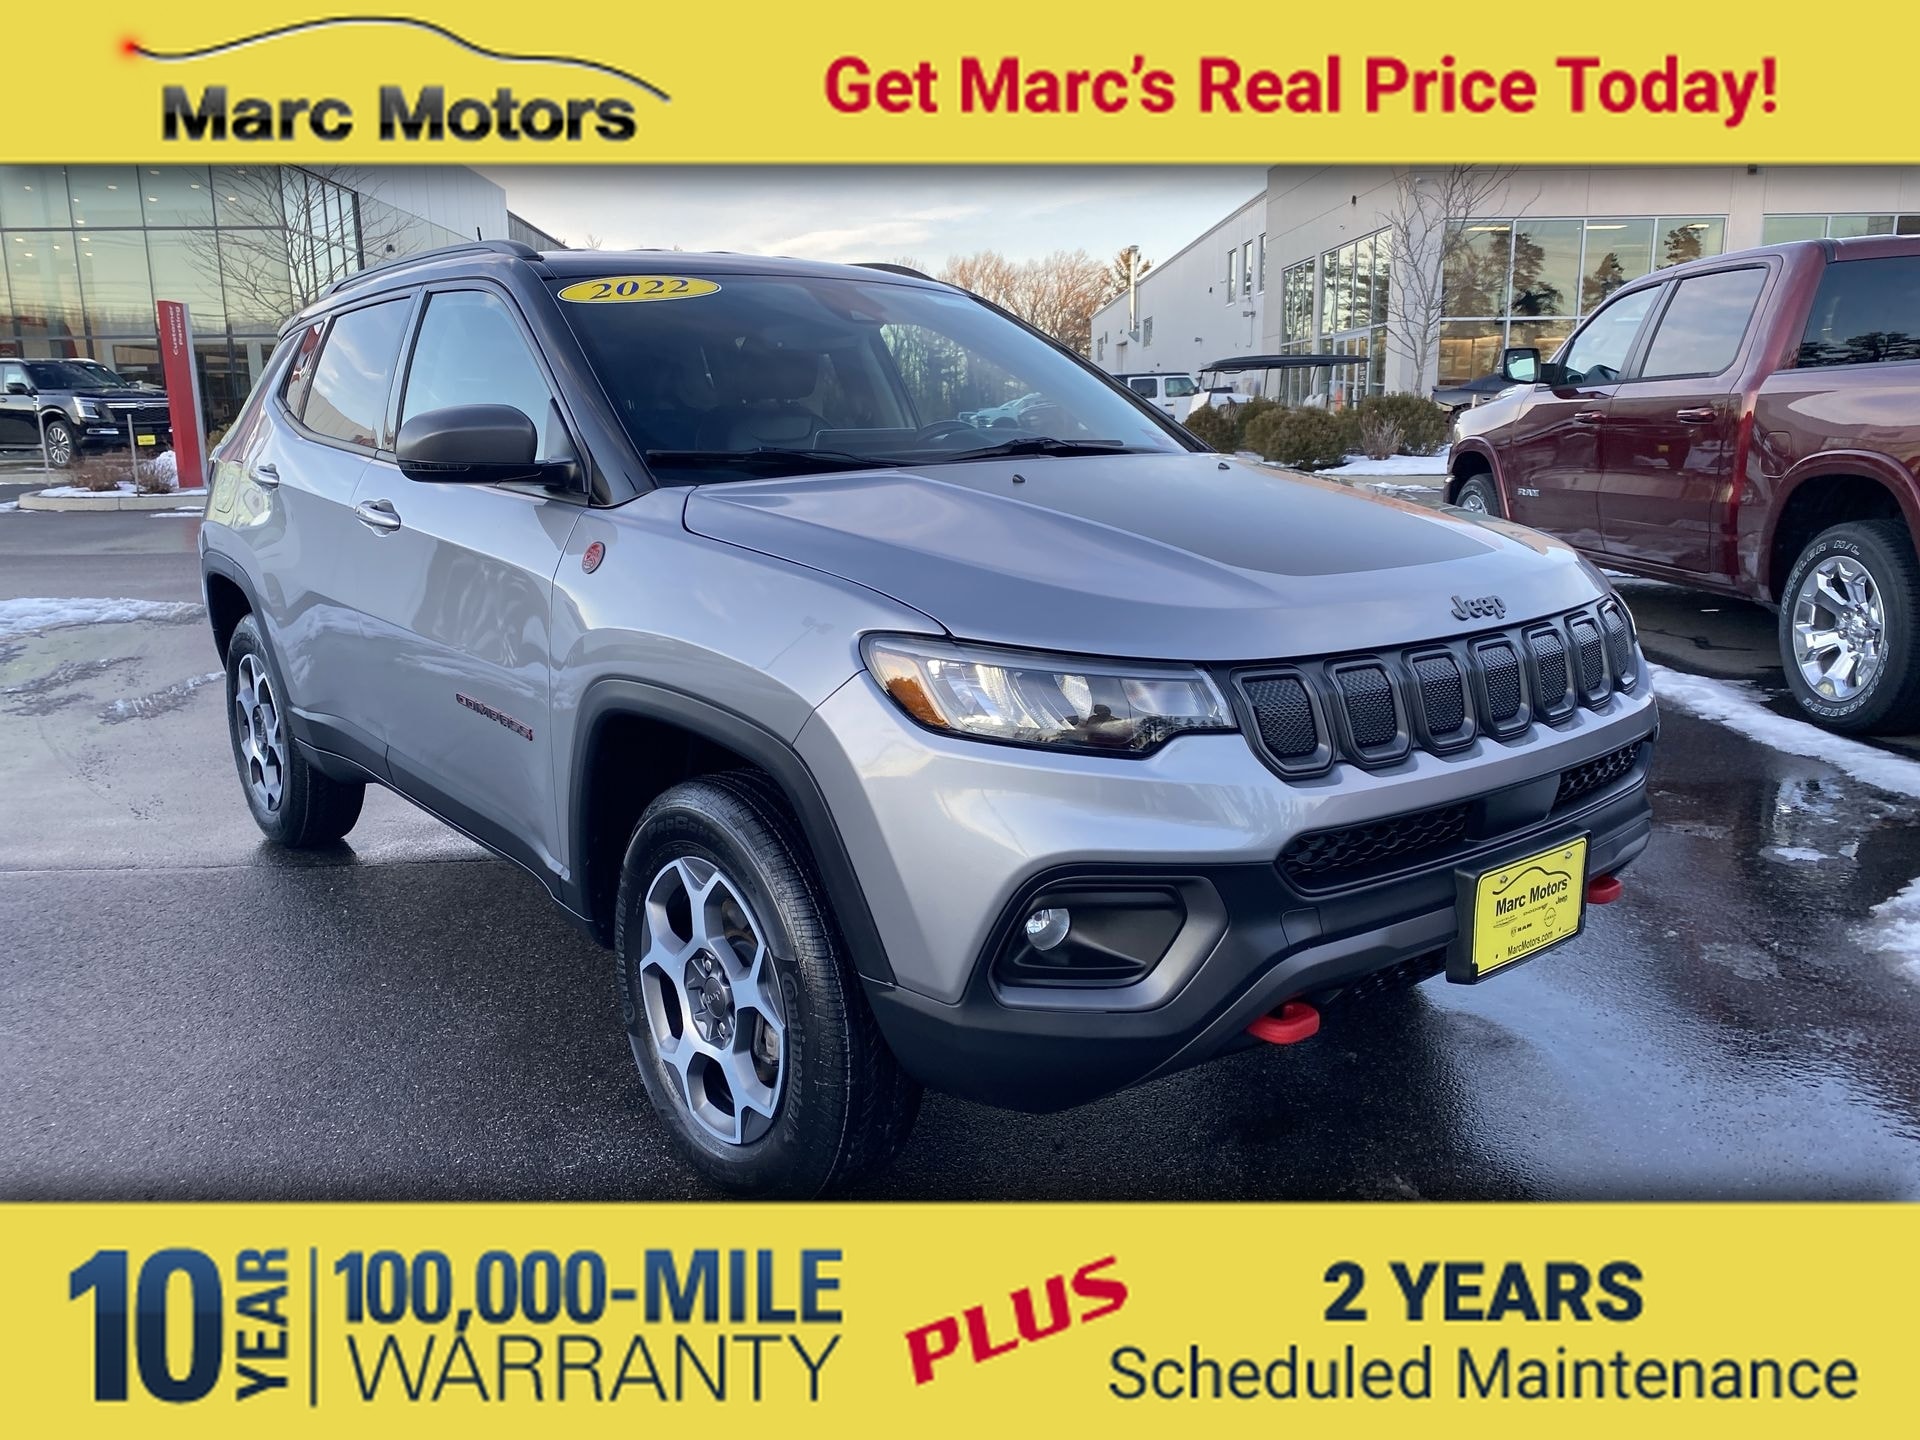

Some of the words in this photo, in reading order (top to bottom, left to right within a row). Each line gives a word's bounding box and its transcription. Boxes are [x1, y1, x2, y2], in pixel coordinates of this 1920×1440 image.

[590, 280, 689, 299] 2022
[1451, 595, 1506, 621] Jeep
[1496, 895, 1526, 917] Marc
[1530, 879, 1568, 904] Motors
[1508, 932, 1553, 956] MarcMotors.com
